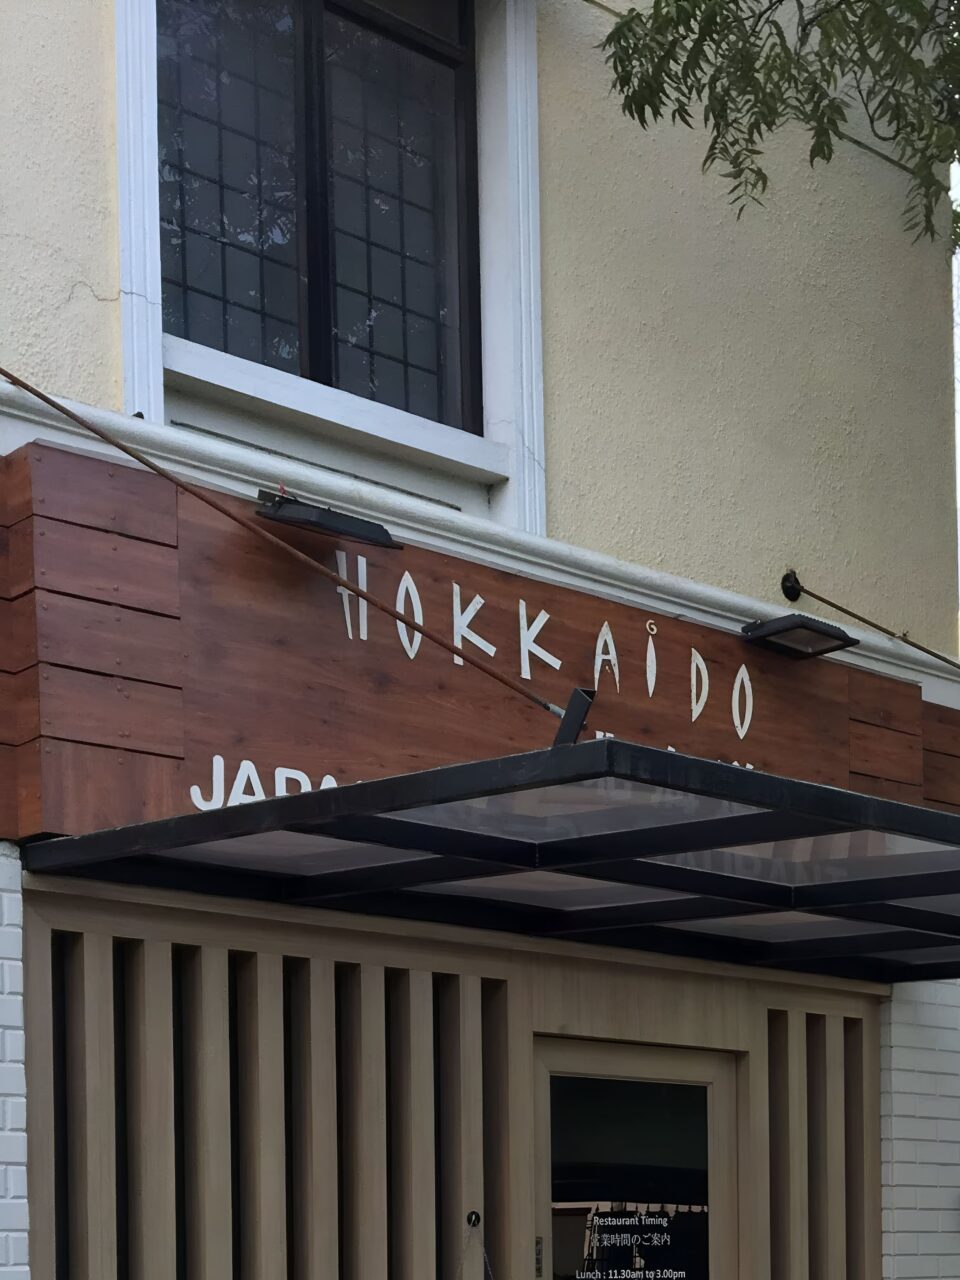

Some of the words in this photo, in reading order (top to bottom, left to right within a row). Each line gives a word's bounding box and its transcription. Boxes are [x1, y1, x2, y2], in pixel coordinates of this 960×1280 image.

[593, 1215, 639, 1226] Restaurant
[641, 1214, 668, 1227] Timing
[575, 1269, 601, 1279] Lunch
[608, 1269, 644, 1279] 11.30am
[645, 1270, 654, 1279] to
[656, 1269, 686, 1280] 3.00pm
